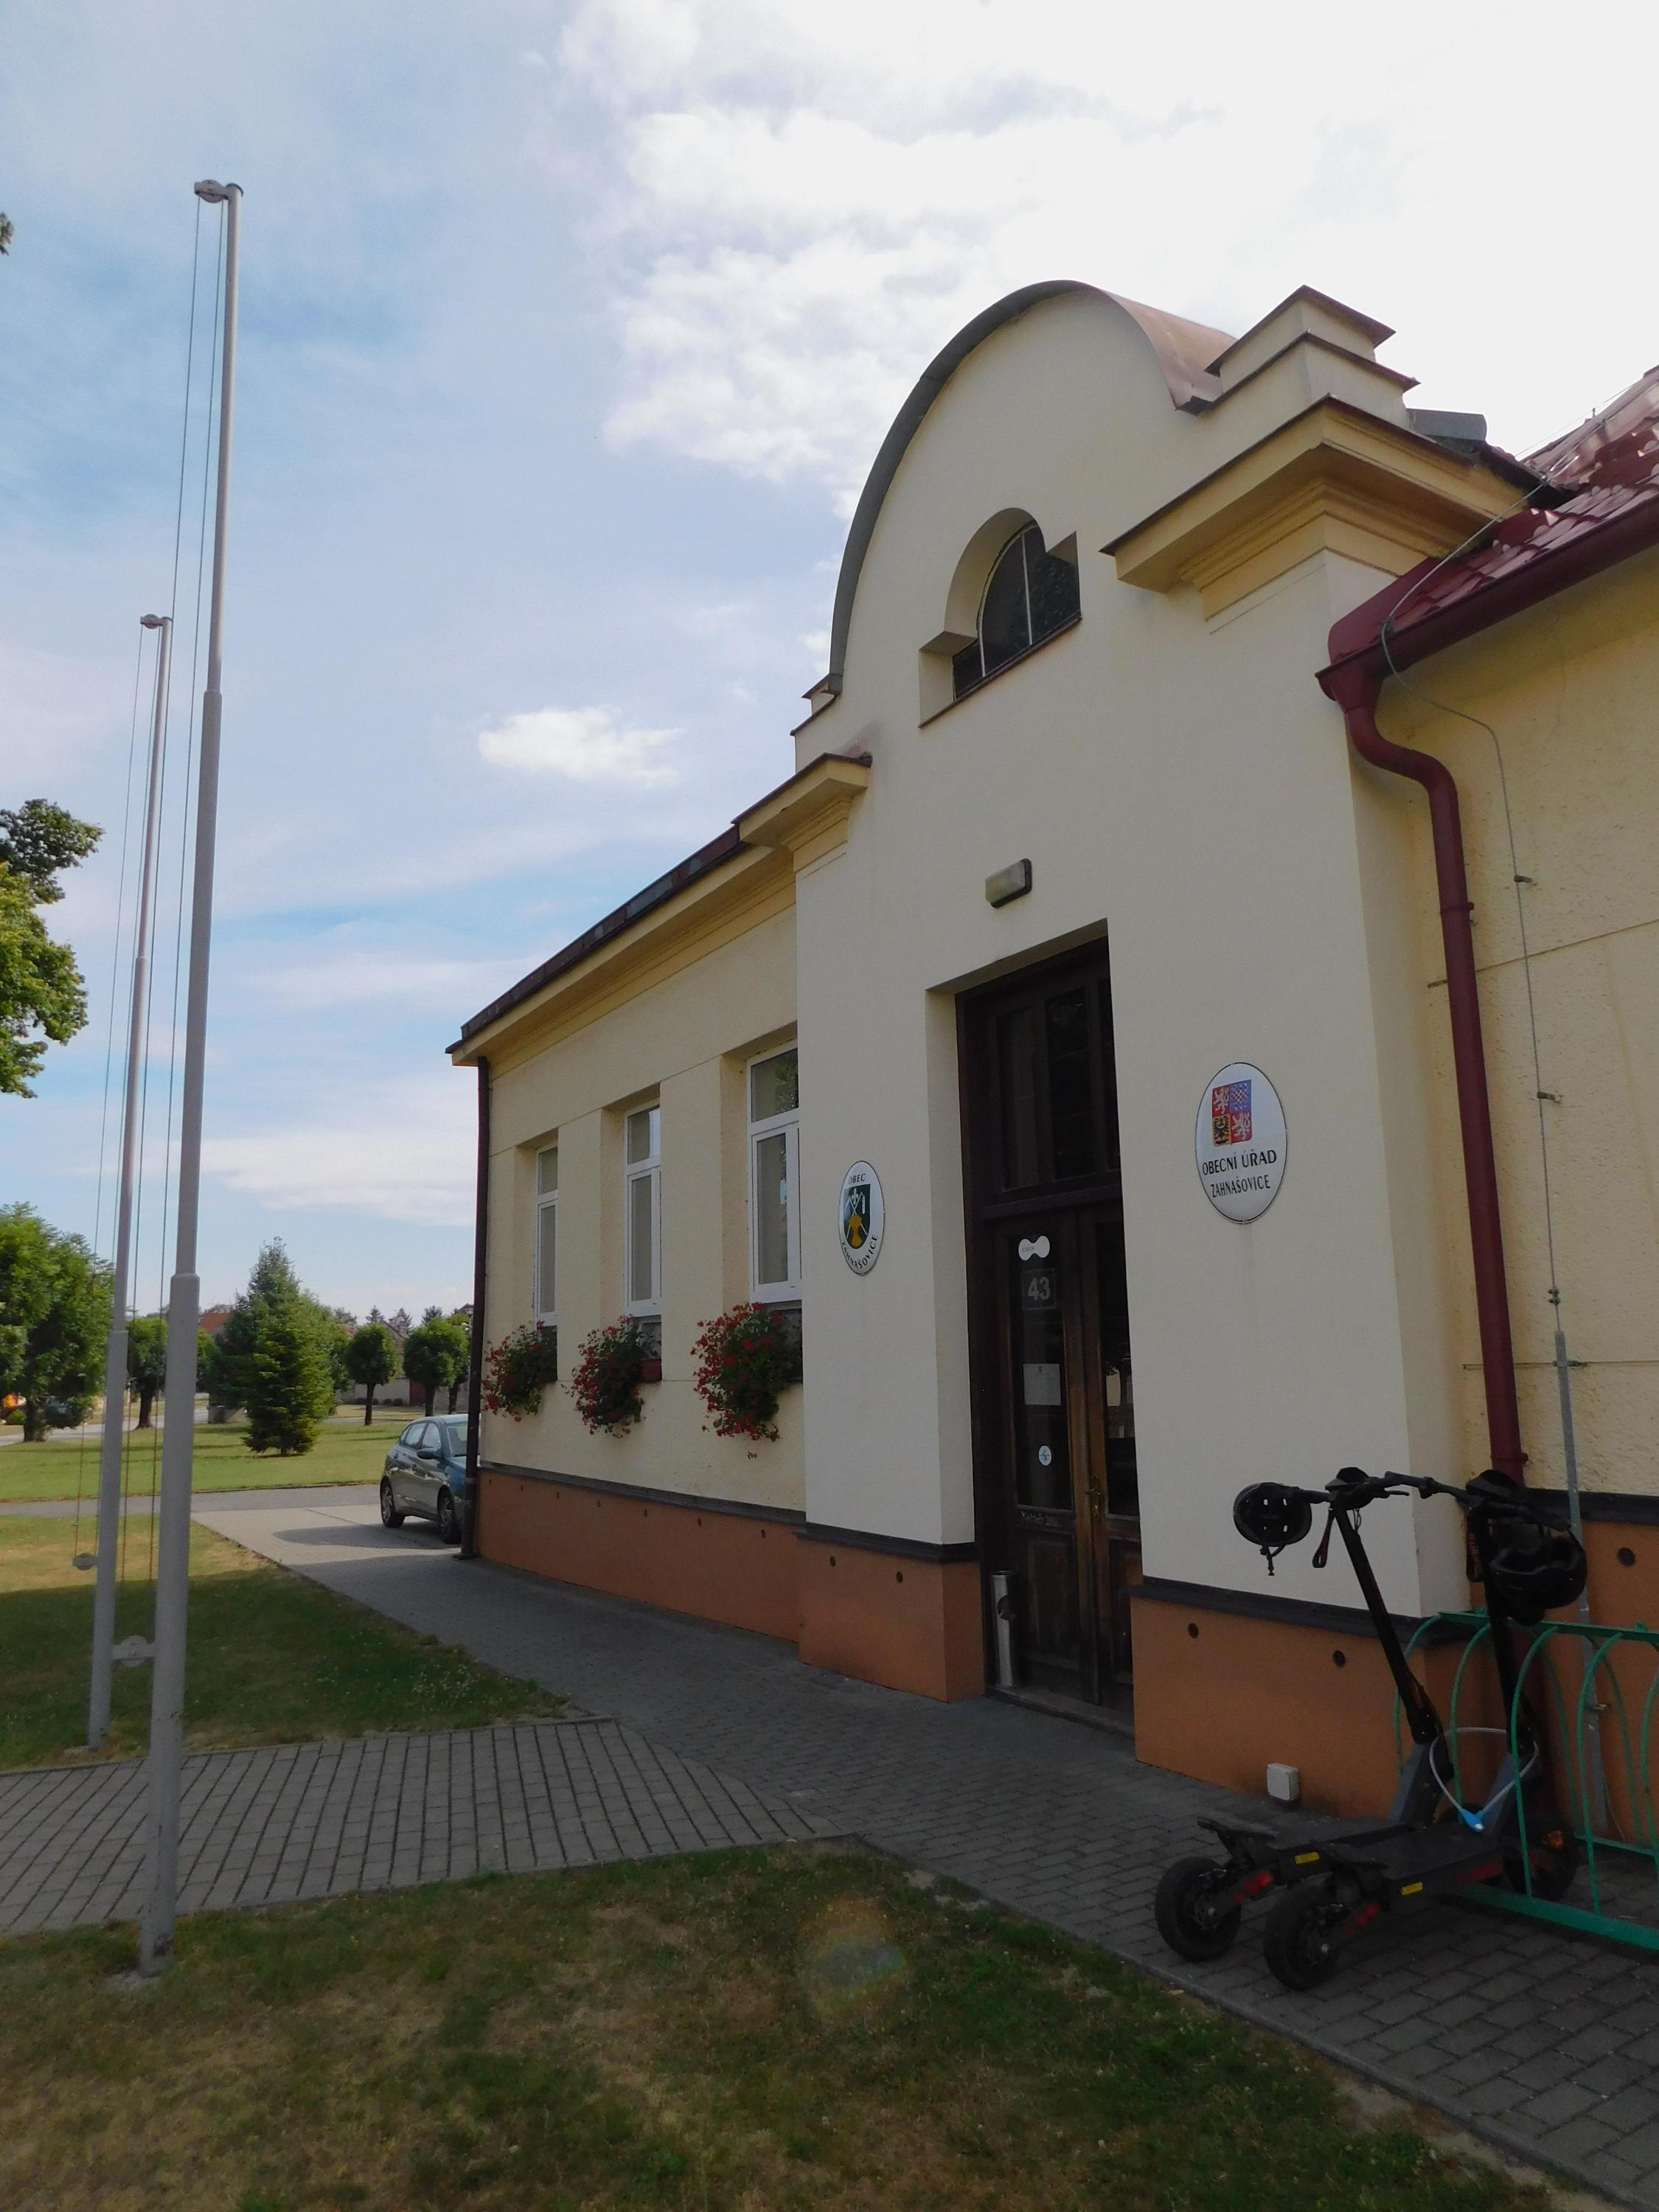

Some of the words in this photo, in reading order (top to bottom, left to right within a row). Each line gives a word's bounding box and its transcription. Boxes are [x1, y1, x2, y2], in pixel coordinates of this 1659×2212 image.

[1202, 1152, 1237, 1175] OBECNÍ
[1241, 1149, 1277, 1168] ÚŘAD
[848, 1173, 866, 1184] OBEC
[1211, 1175, 1270, 1198] ZAHNAŠOVICE
[1027, 1276, 1051, 1301] 43
